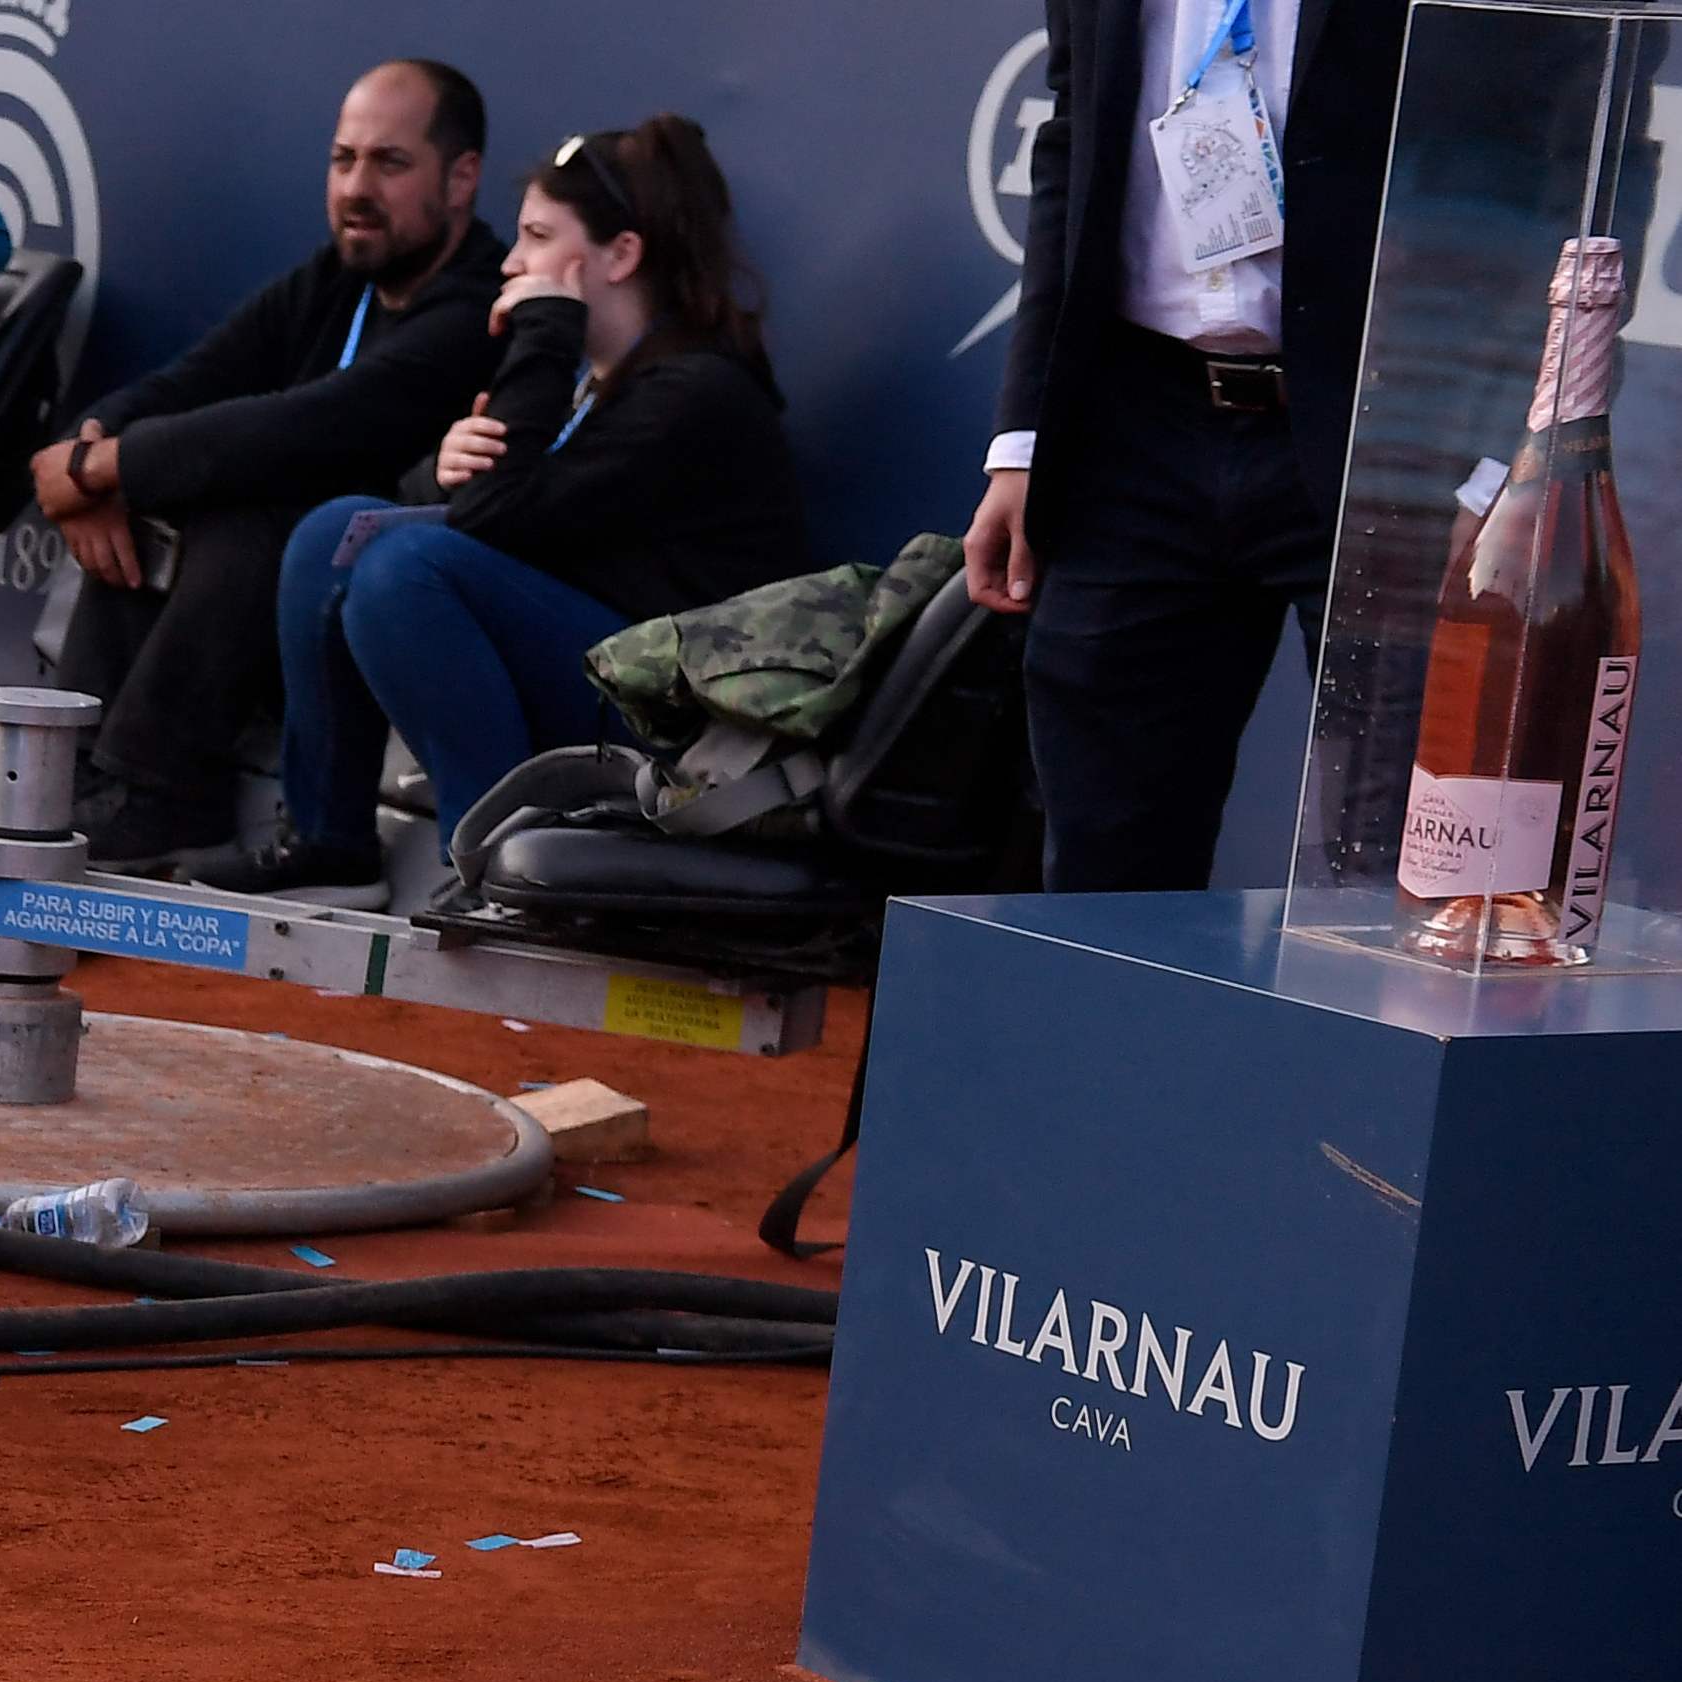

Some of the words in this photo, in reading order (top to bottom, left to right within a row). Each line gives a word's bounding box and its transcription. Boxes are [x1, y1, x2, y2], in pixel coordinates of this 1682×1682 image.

[1565, 660, 1632, 940] VILARNAU
[3, 909, 121, 942] AGARRARSE
[125, 929, 139, 945] A
[143, 930, 167, 948] LA
[171, 931, 241, 957] "COPA"
[22, 891, 73, 915] PARA
[78, 900, 135, 924] SUBIR
[139, 908, 153, 926] Y
[157, 910, 220, 936] BAJAR
[924, 1247, 1305, 1441] VILARNAU
[1050, 1395, 1133, 1451] CAVA
